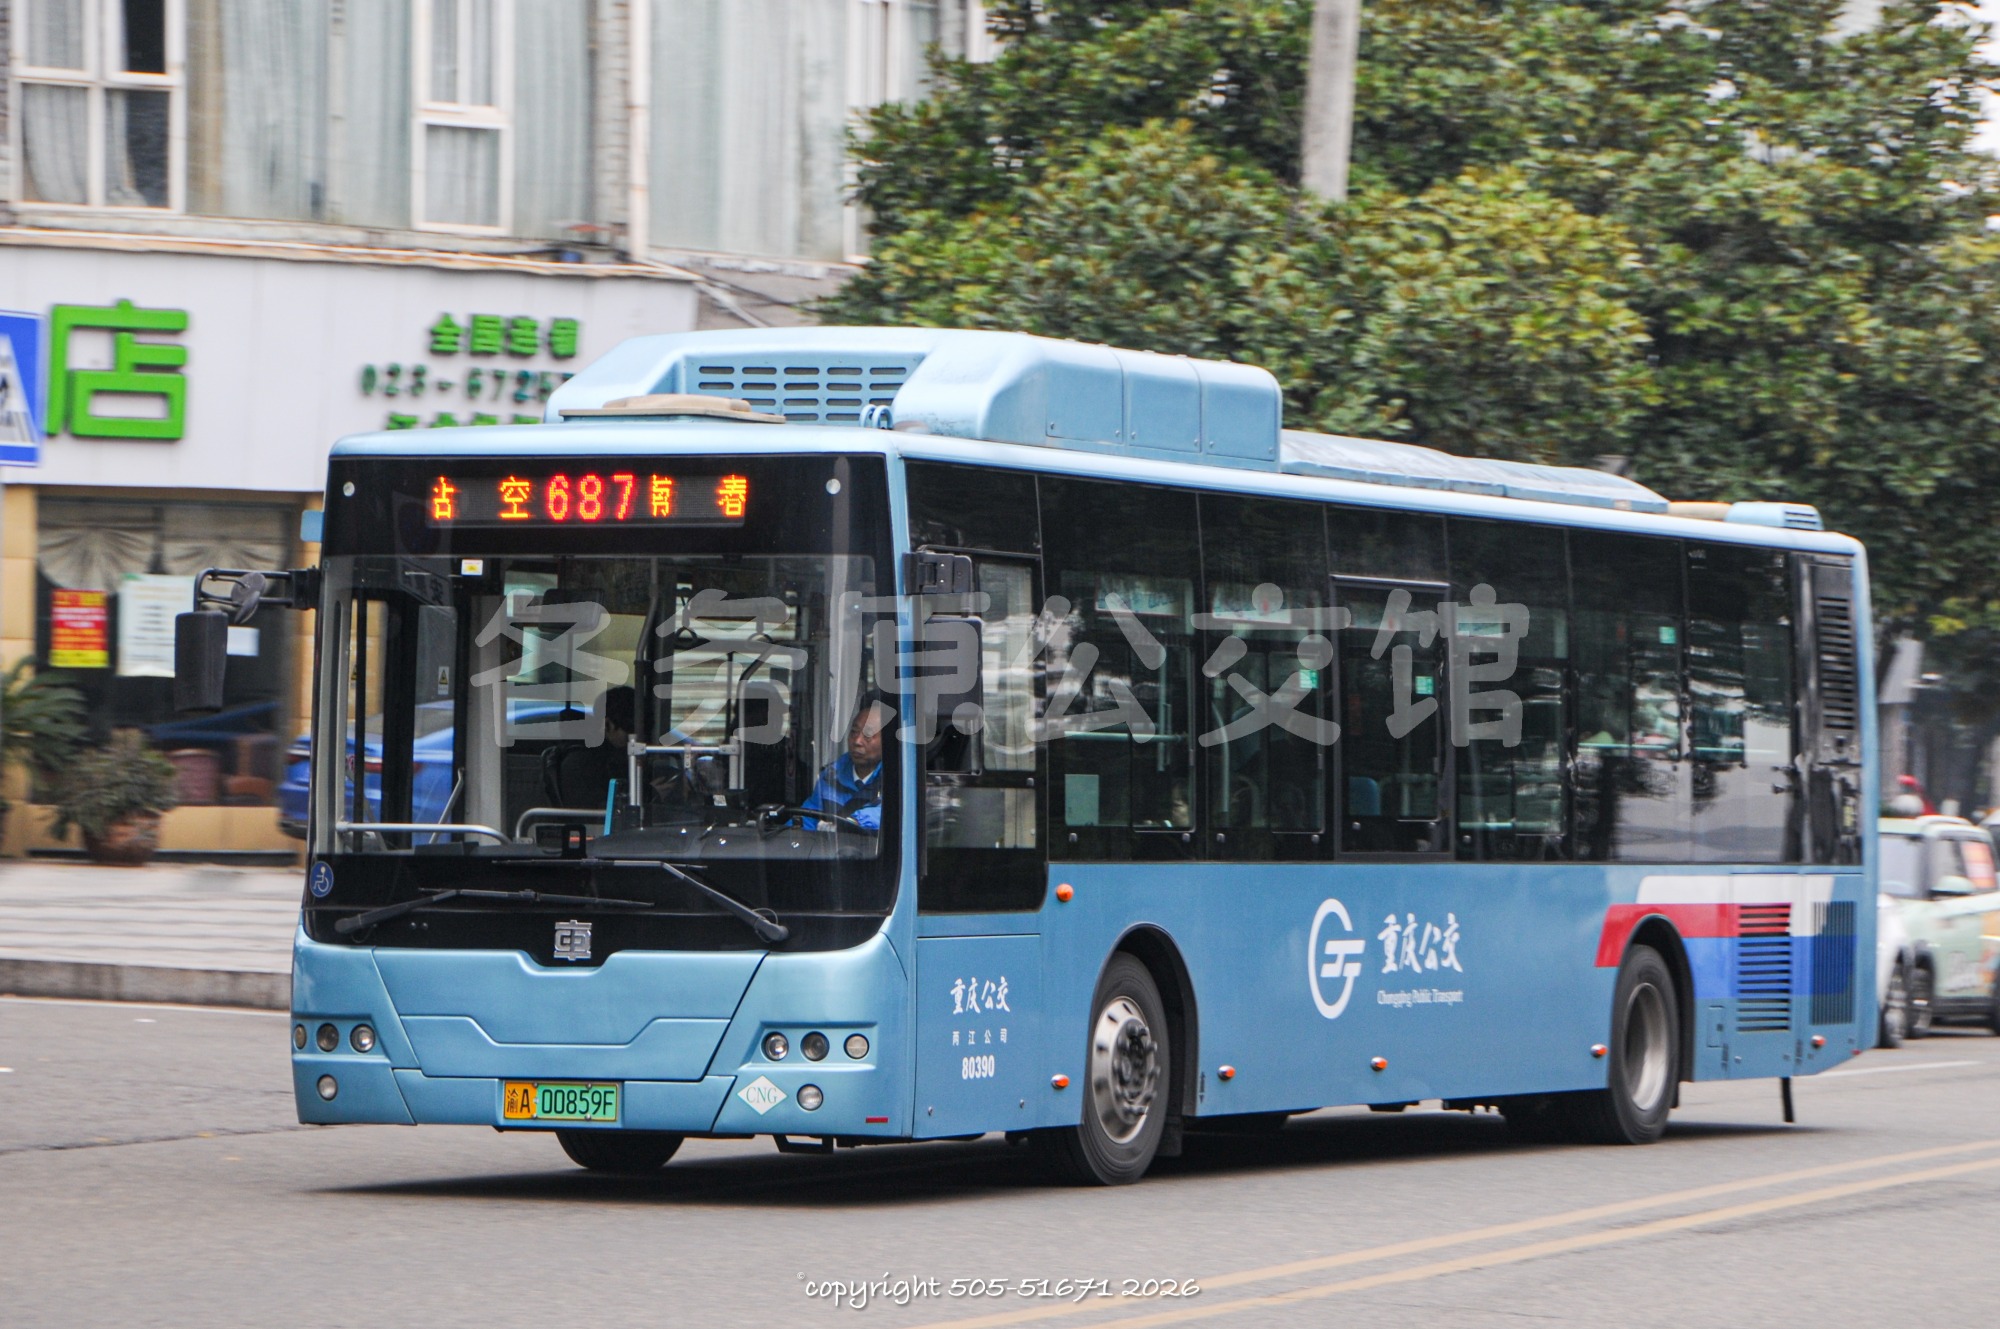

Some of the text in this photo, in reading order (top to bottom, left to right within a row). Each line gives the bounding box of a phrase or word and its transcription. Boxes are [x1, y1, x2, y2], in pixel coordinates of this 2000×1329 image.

[46, 299, 188, 440] 店
[548, 474, 634, 520] 687
[1377, 912, 1464, 974] 重庆公交
[950, 976, 1011, 1015] 重庆公交
[962, 1054, 995, 1080] 80390
[746, 1086, 778, 1104] CNG
